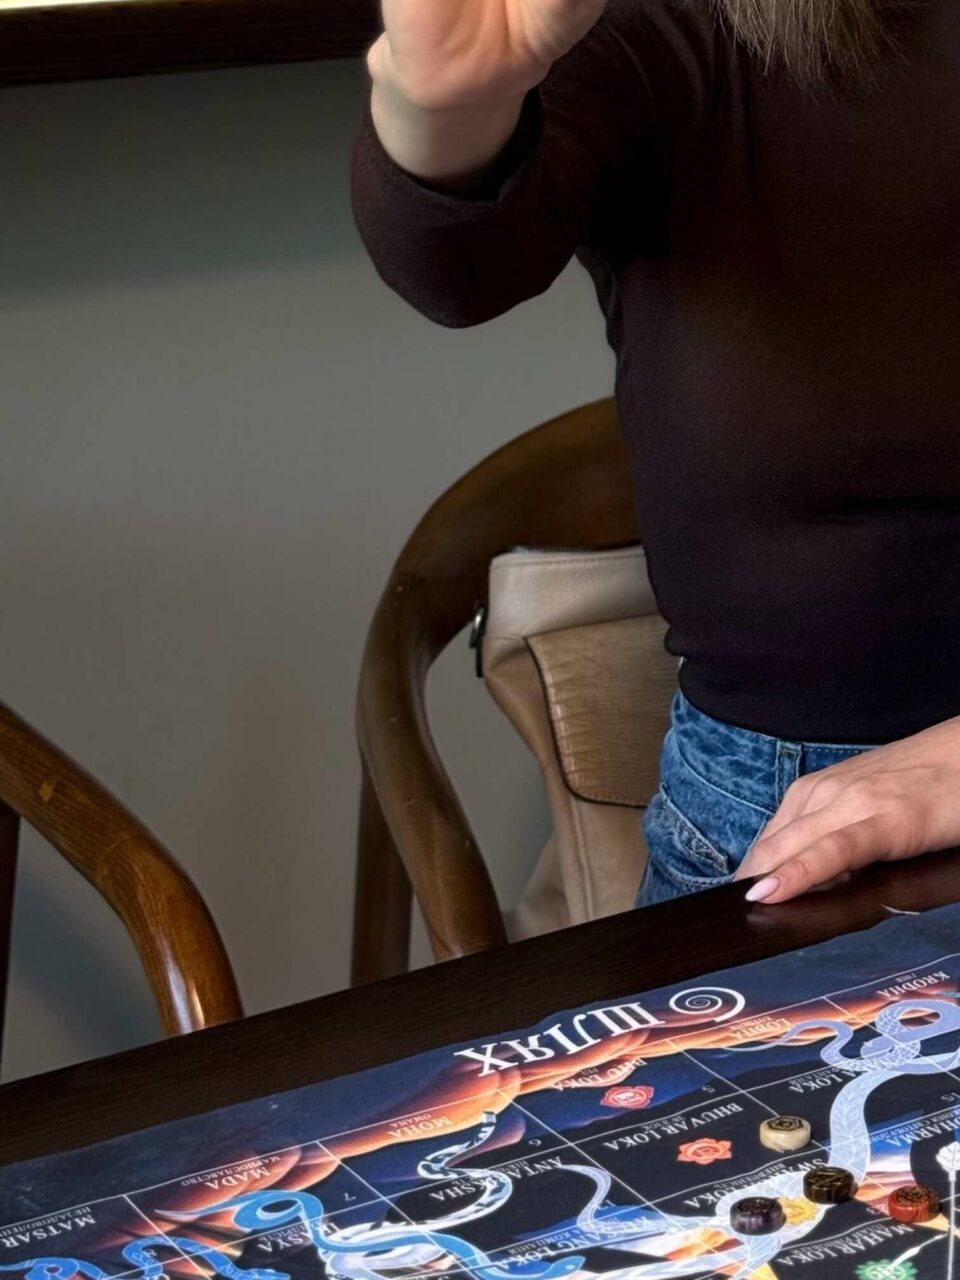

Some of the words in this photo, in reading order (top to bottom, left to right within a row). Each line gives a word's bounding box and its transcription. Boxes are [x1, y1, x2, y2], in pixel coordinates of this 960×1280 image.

[875, 970, 950, 999] KRODHA
[453, 1002, 666, 1077] ШЛЯХ
[788, 1073, 844, 1094] LOKA
[386, 1115, 454, 1140] MOHA
[661, 1102, 744, 1135] BHUVAR
[528, 1138, 542, 1147] 6
[603, 1129, 663, 1151] LOKA
[180, 1155, 281, 1187] МАРНОСЛАВСТВО
[204, 1166, 271, 1190] MADA
[343, 1192, 357, 1201] 7
[835, 1223, 914, 1254] MAHAR
[494, 1245, 558, 1271] LOKA
[775, 1246, 839, 1266] LOKA
